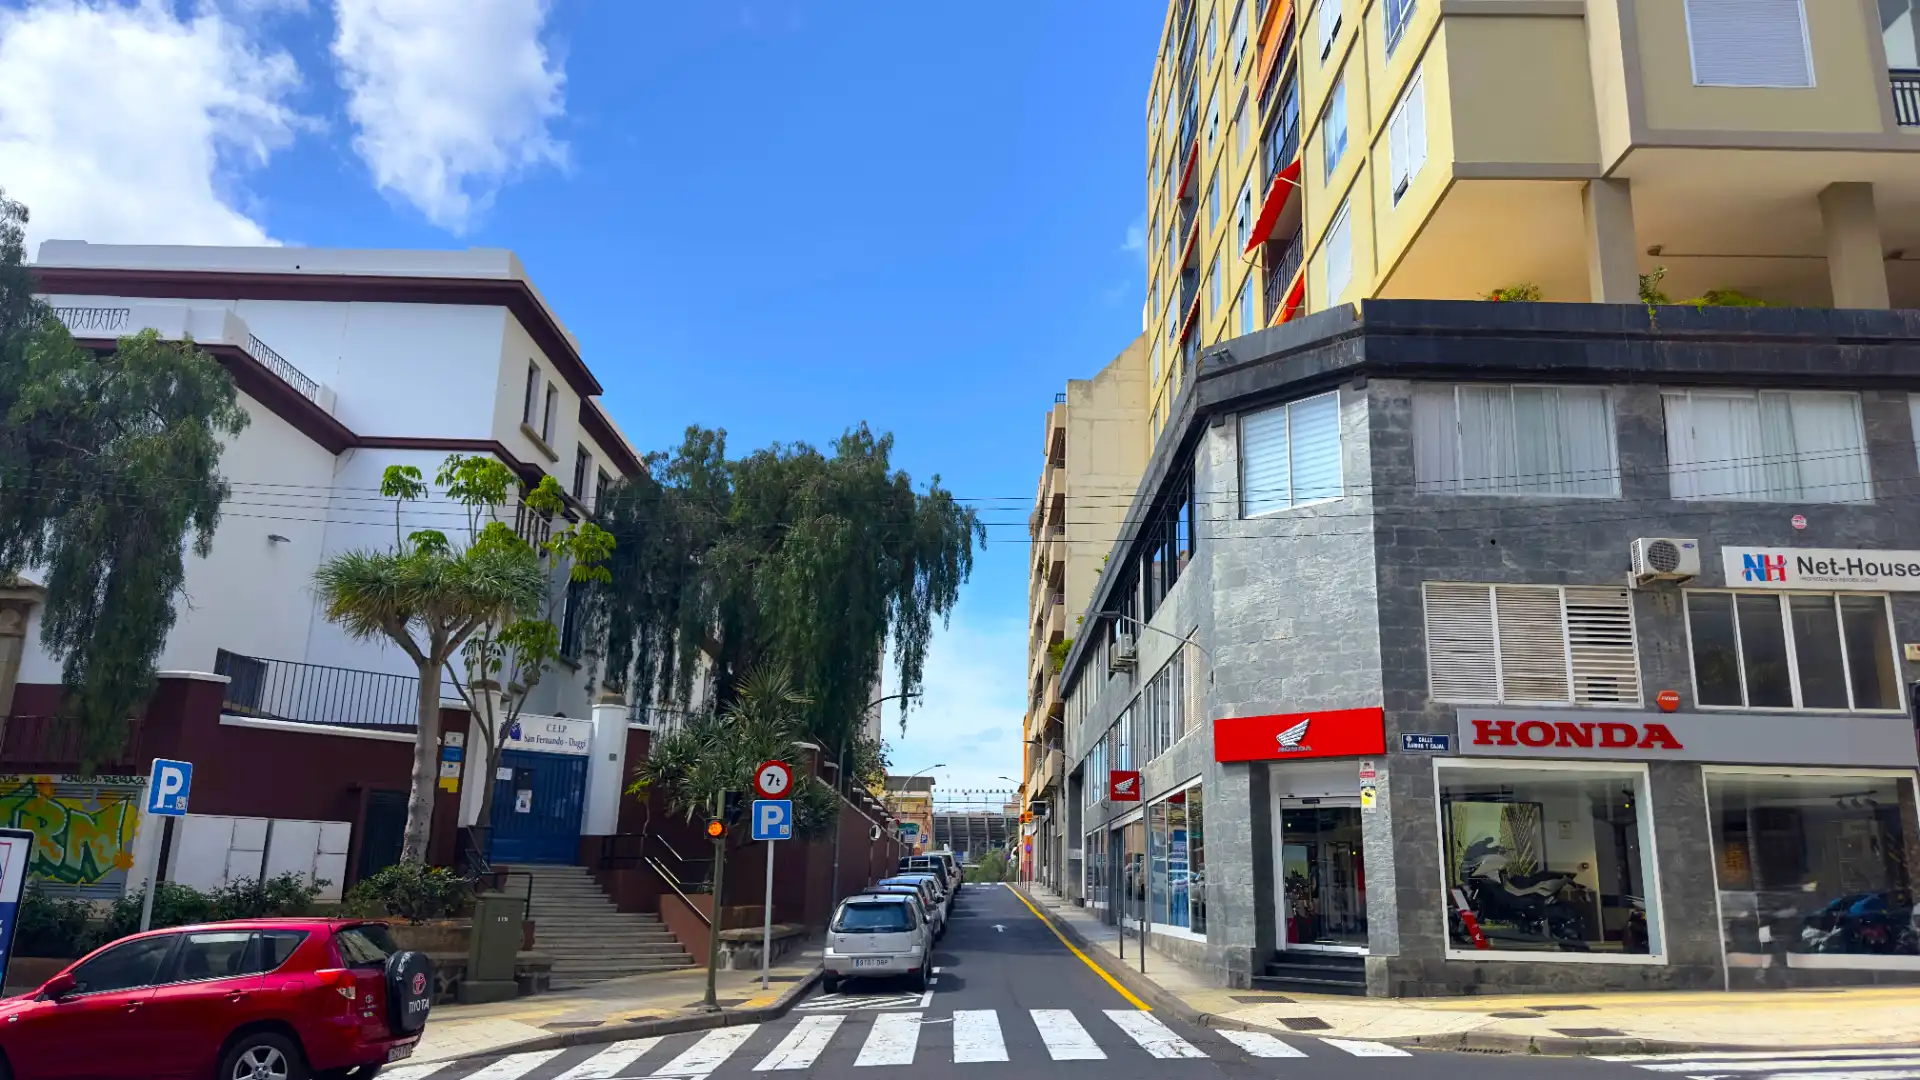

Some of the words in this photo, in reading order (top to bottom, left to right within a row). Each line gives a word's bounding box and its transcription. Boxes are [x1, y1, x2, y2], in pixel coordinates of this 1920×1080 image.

[1796, 555, 1920, 577] Net-House
[524, 734, 535, 743] San
[536, 735, 563, 746] Fernando
[1471, 719, 1684, 749] HONDA
[156, 766, 184, 808] P
[761, 805, 784, 835] P
